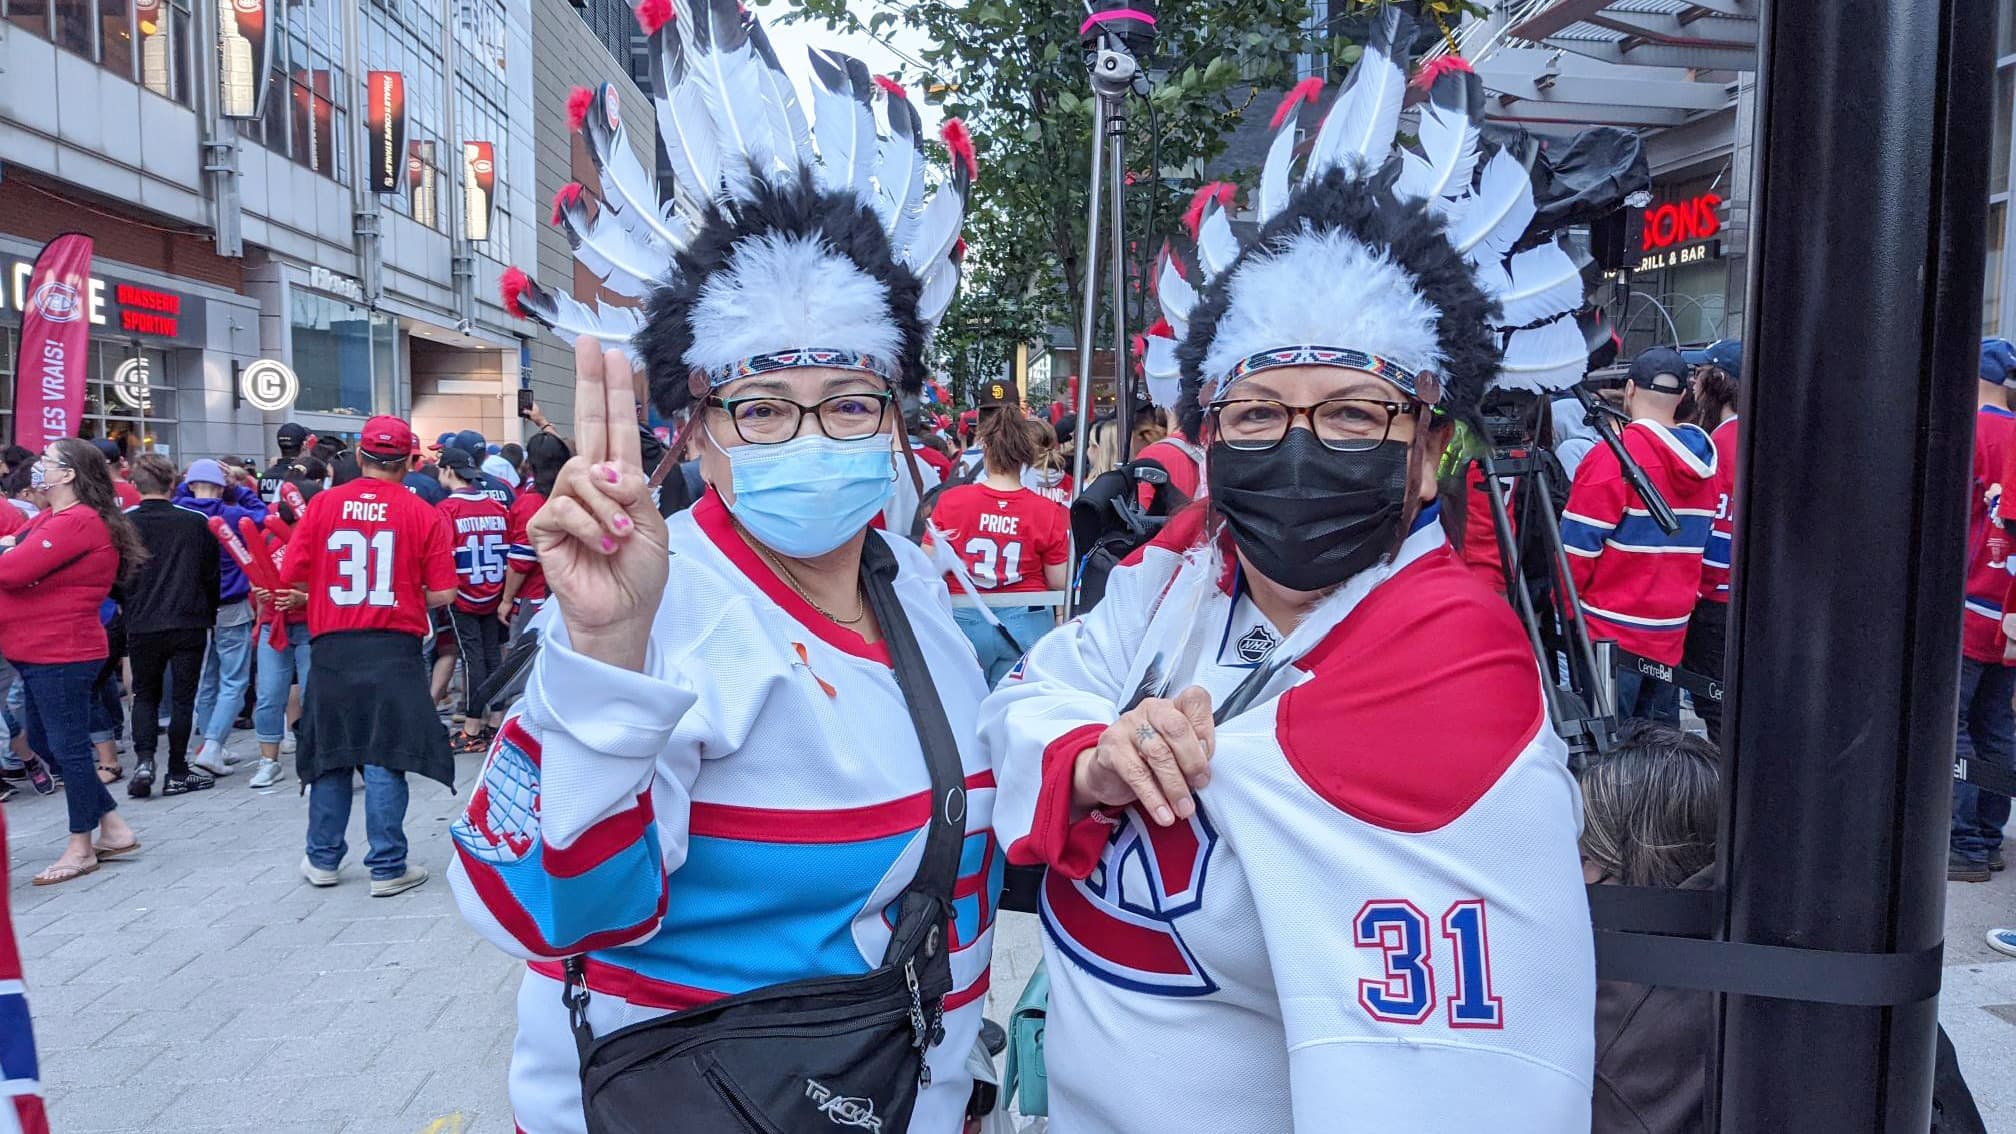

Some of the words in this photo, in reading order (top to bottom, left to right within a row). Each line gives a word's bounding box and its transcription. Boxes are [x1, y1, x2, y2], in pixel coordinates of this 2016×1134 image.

[384, 112, 392, 140] COUPE
[384, 140, 393, 176] STANLEY
[1634, 254, 1665, 273] RILL
[1668, 251, 1677, 265] &
[1681, 245, 1706, 263] BAR
[116, 284, 180, 315] BRASSERIE
[121, 309, 178, 337] SPORTIVE
[42, 339, 65, 401] VRAIS!
[257, 371, 281, 399] C
[43, 406, 67, 442] LES
[342, 500, 388, 522] PRICE
[979, 513, 1019, 535] PRICE
[326, 529, 395, 607] 31
[466, 534, 504, 584] 15
[965, 537, 1023, 590] 31
[1241, 640, 1268, 650] NHL
[1638, 657, 1673, 683] CentreBell
[1353, 898, 1504, 1030] 31
